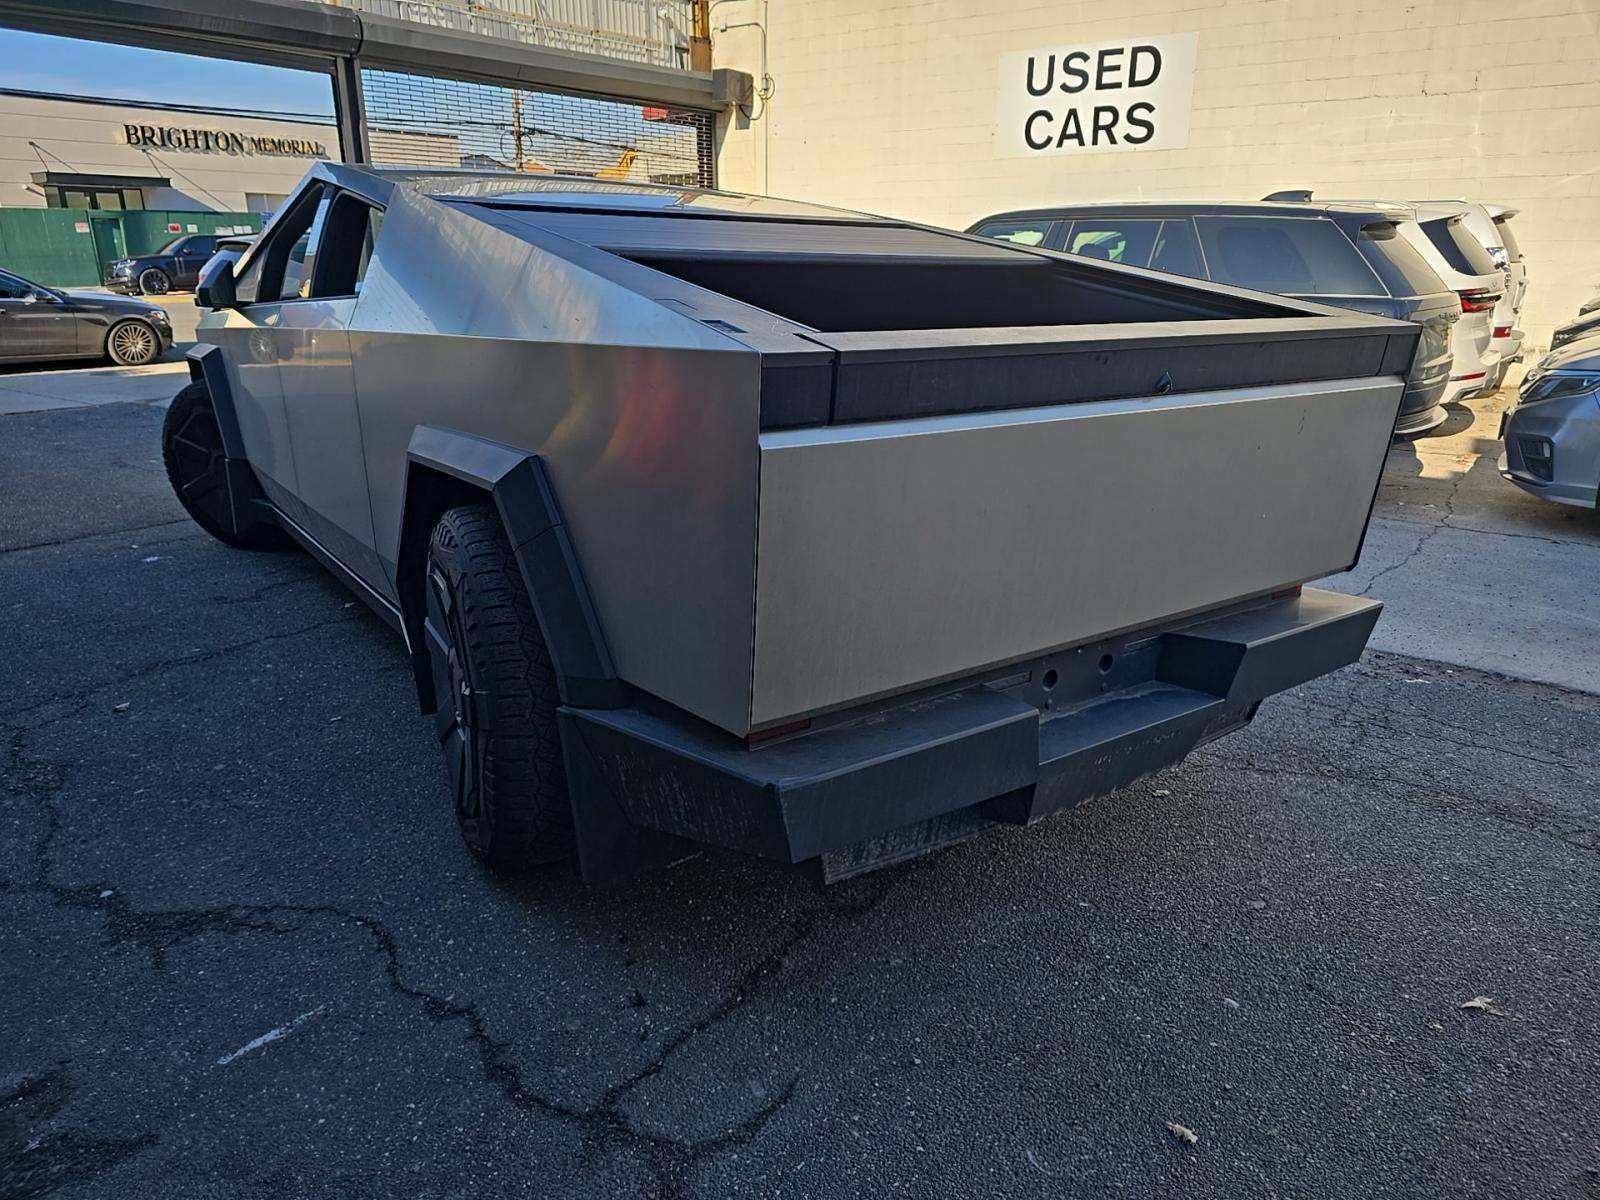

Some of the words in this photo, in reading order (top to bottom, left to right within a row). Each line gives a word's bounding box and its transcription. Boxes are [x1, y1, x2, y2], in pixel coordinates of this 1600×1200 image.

[1026, 45, 1162, 97] USED
[123, 124, 244, 153] BRIGHTON
[250, 136, 323, 156] MEMORIAL
[1024, 101, 1156, 150] CARS
